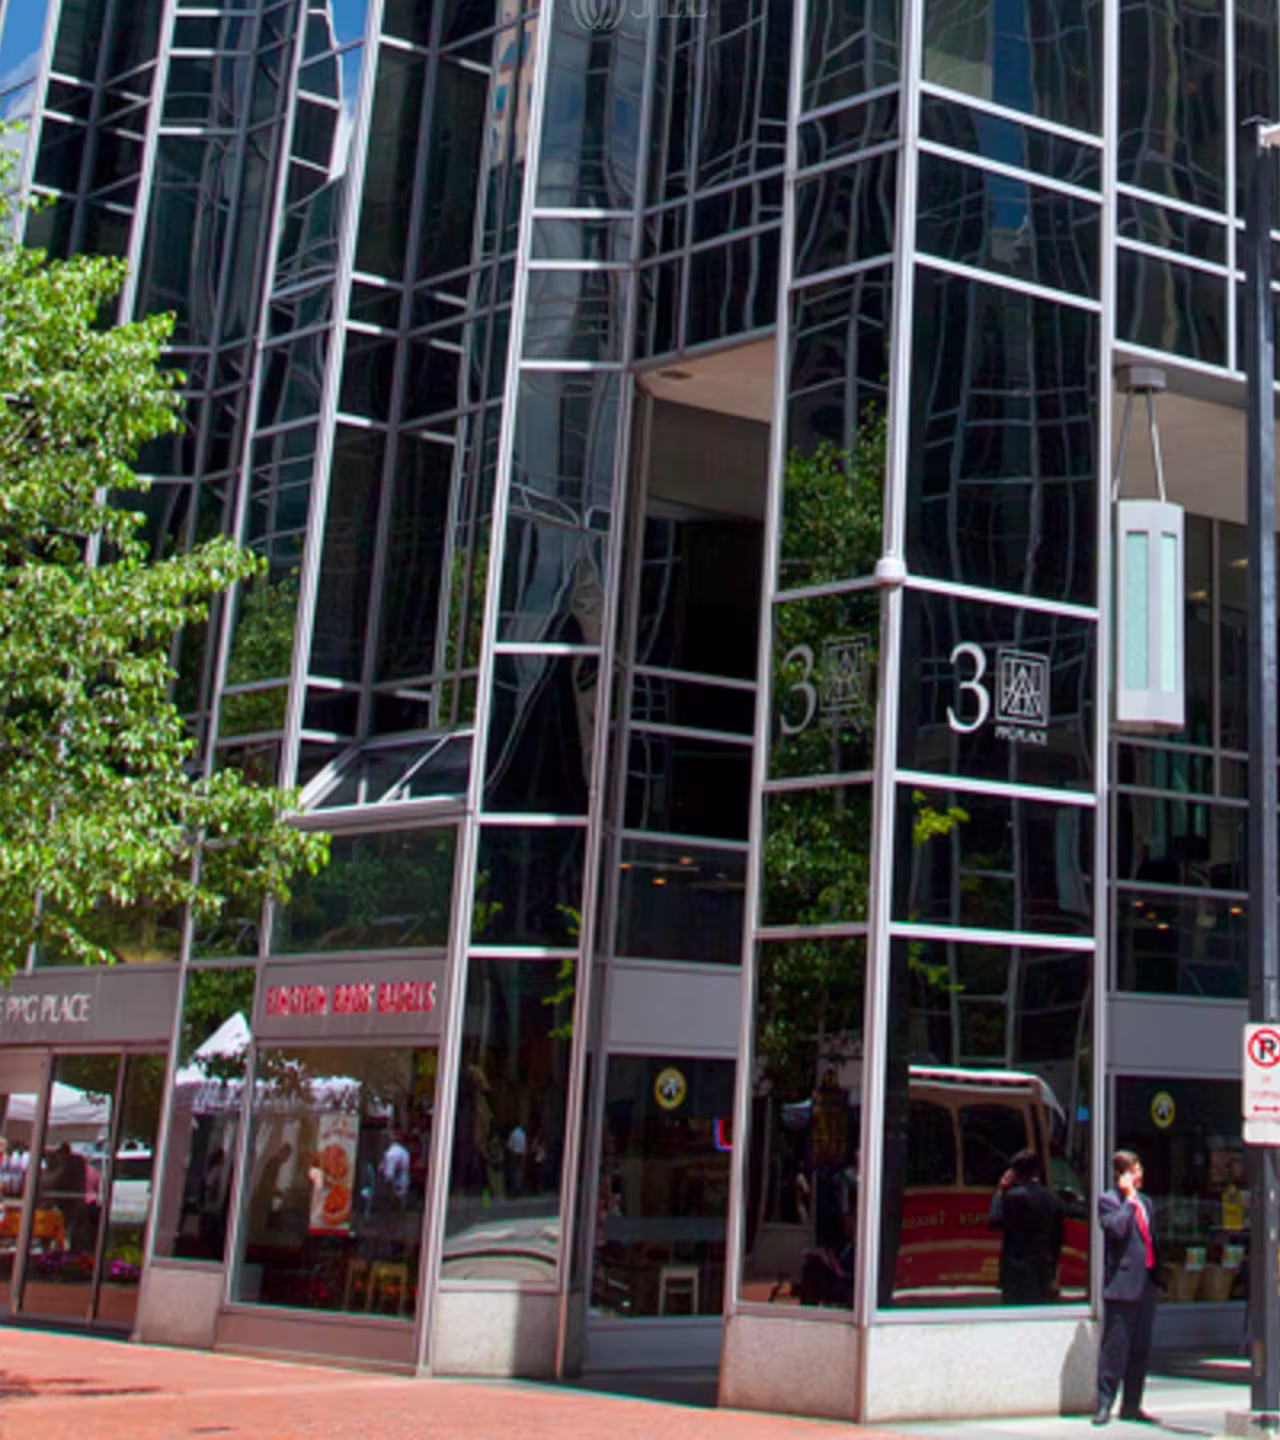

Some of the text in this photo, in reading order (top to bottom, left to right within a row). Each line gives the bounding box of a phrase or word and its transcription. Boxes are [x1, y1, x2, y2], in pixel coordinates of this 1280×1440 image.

[780, 644, 817, 734] 3
[946, 642, 990, 733] 3
[40, 992, 91, 1023] PLACE
